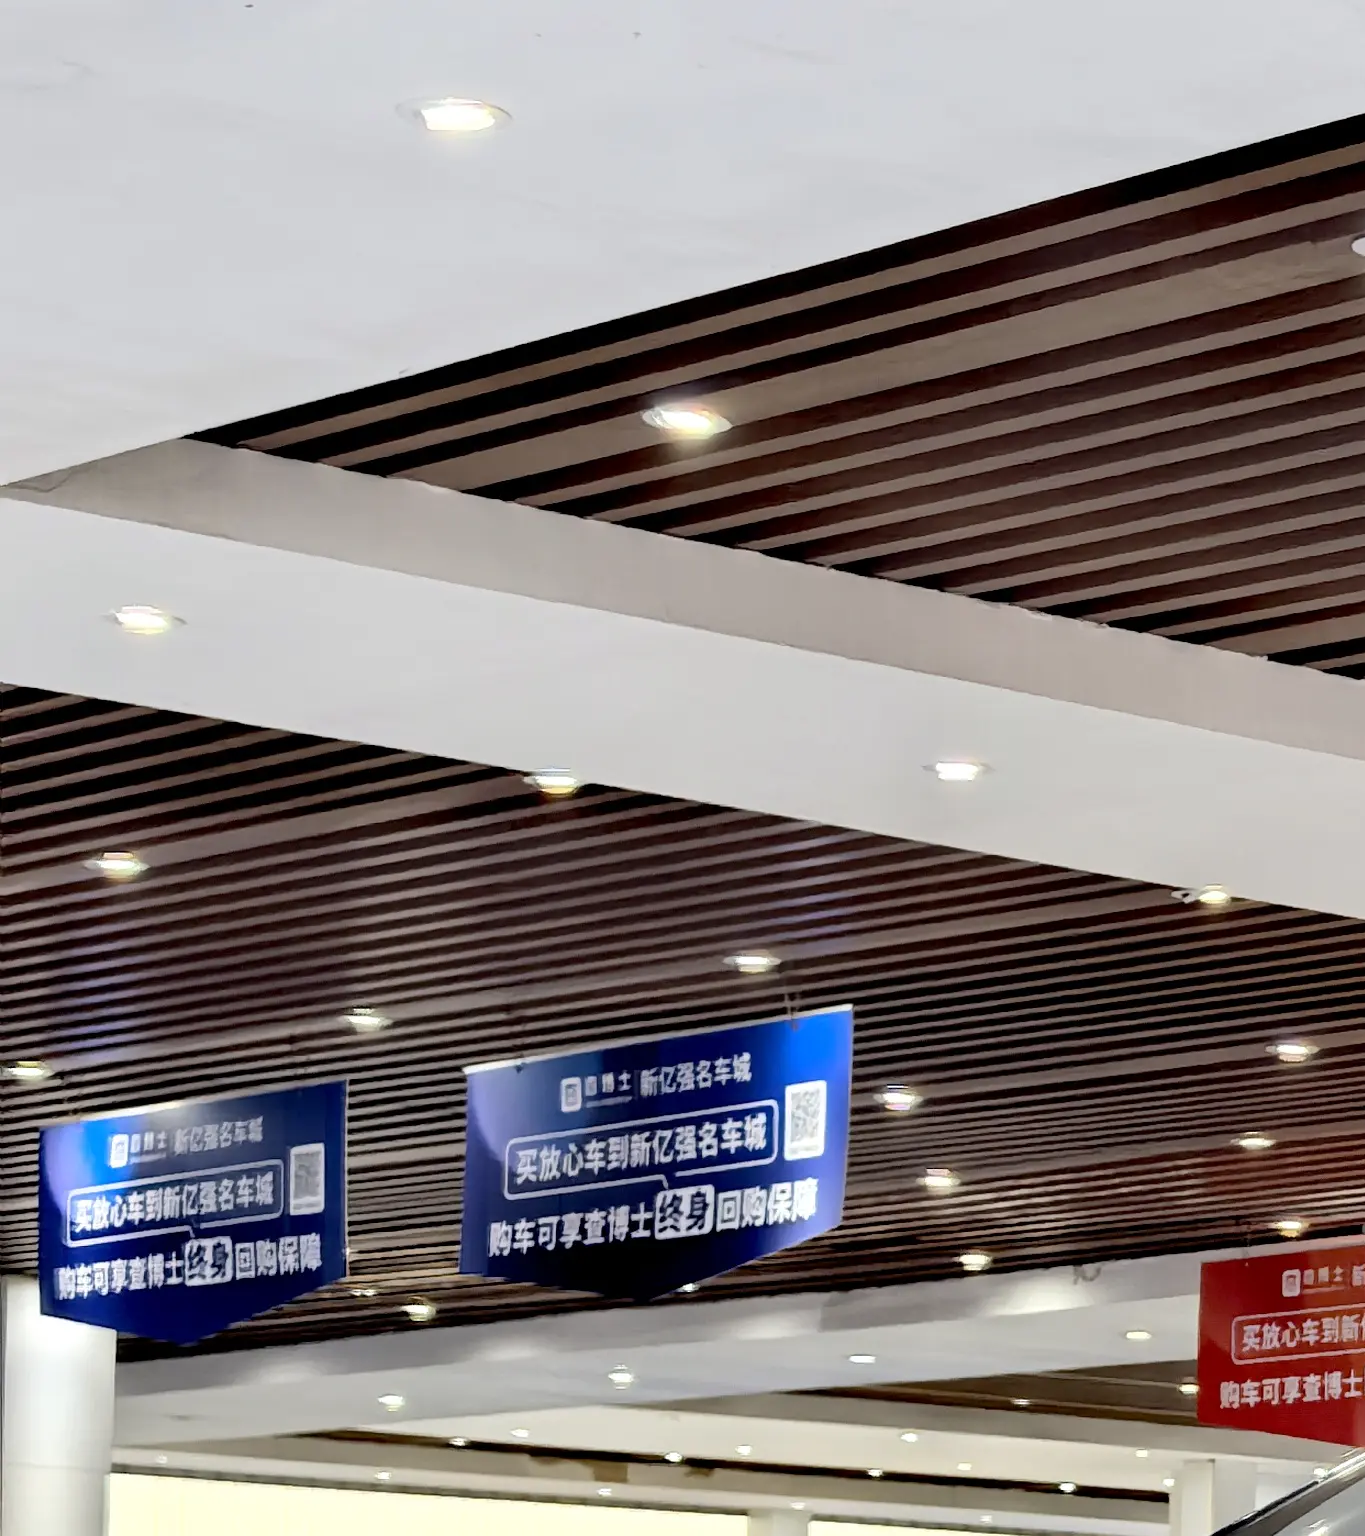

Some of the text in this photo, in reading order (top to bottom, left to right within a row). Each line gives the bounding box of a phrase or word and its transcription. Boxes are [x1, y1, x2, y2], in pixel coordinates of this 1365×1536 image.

[515, 1113, 768, 1186] 买放心车到新亿强名车城
[75, 1171, 274, 1233] 买放心车到新亿强名车城
[487, 1177, 820, 1258] 购车可享查博士终身回购保障
